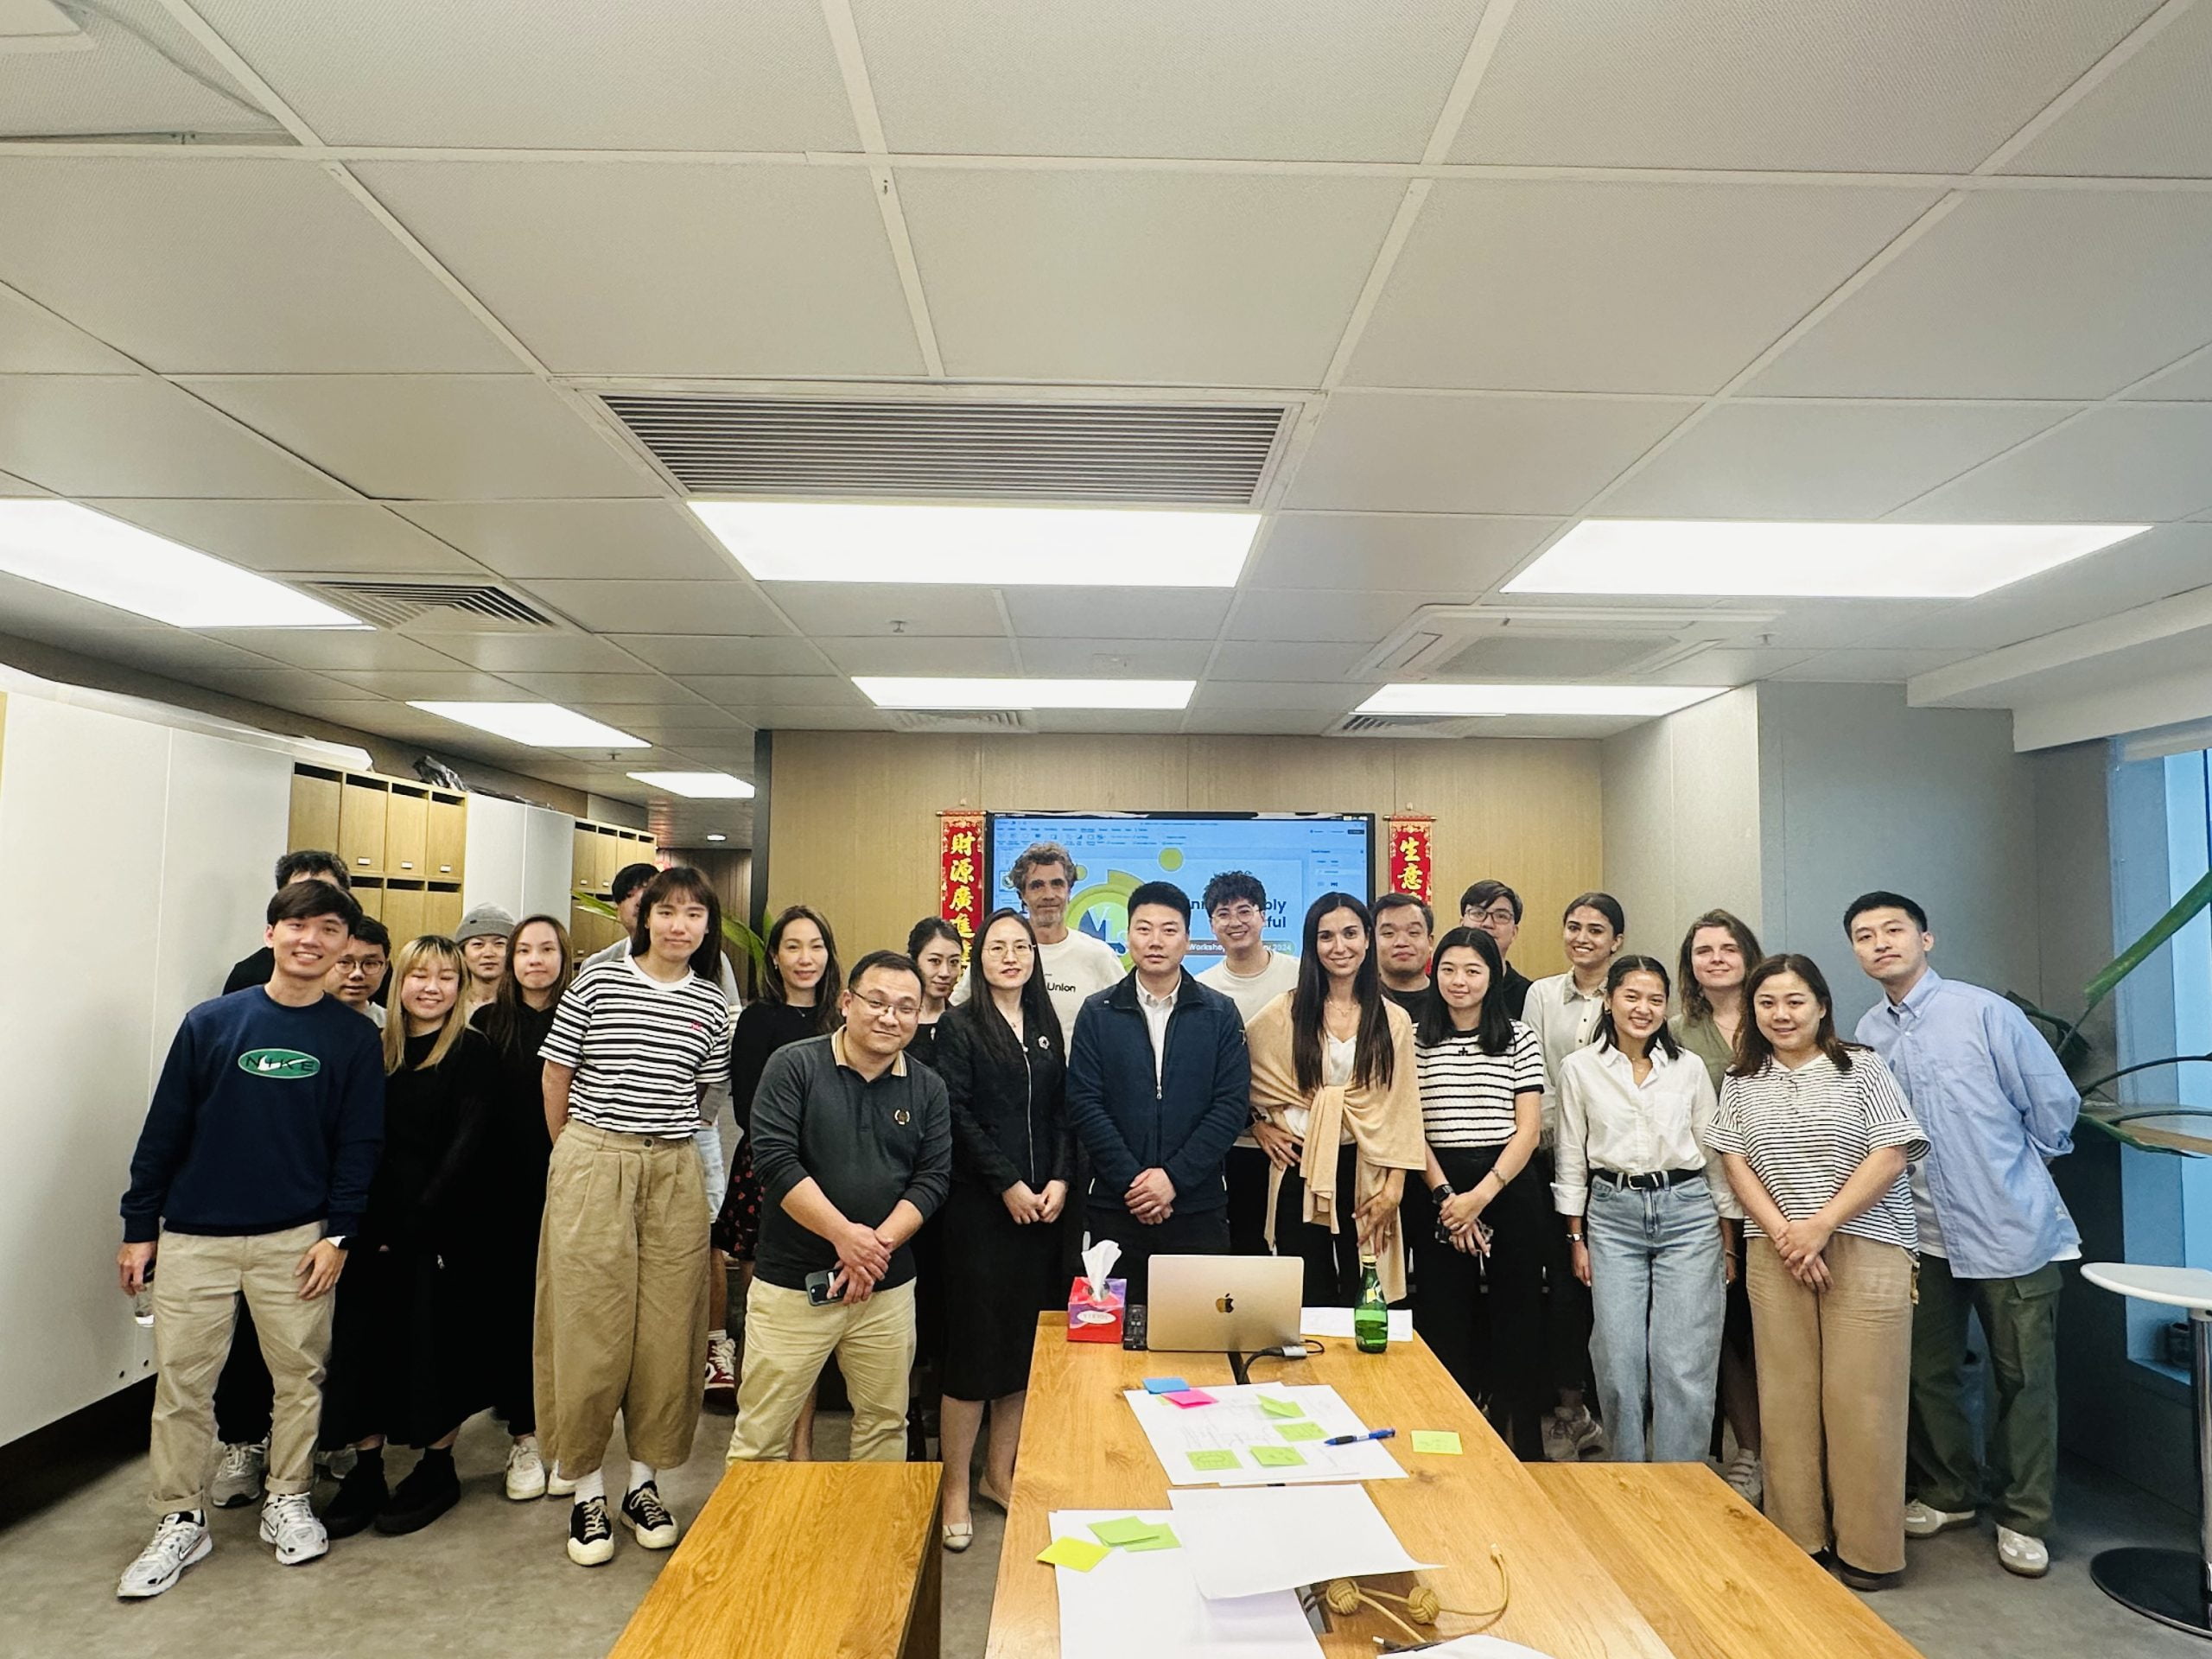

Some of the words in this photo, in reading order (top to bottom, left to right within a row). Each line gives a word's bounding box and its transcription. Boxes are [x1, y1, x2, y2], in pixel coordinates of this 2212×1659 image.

[1397, 836, 1424, 900] 生意
[1263, 916, 1287, 928] ful
[1189, 943, 1225, 953] Worksho
[1046, 982, 1077, 993] Union
[245, 1055, 315, 1072] NIKE
